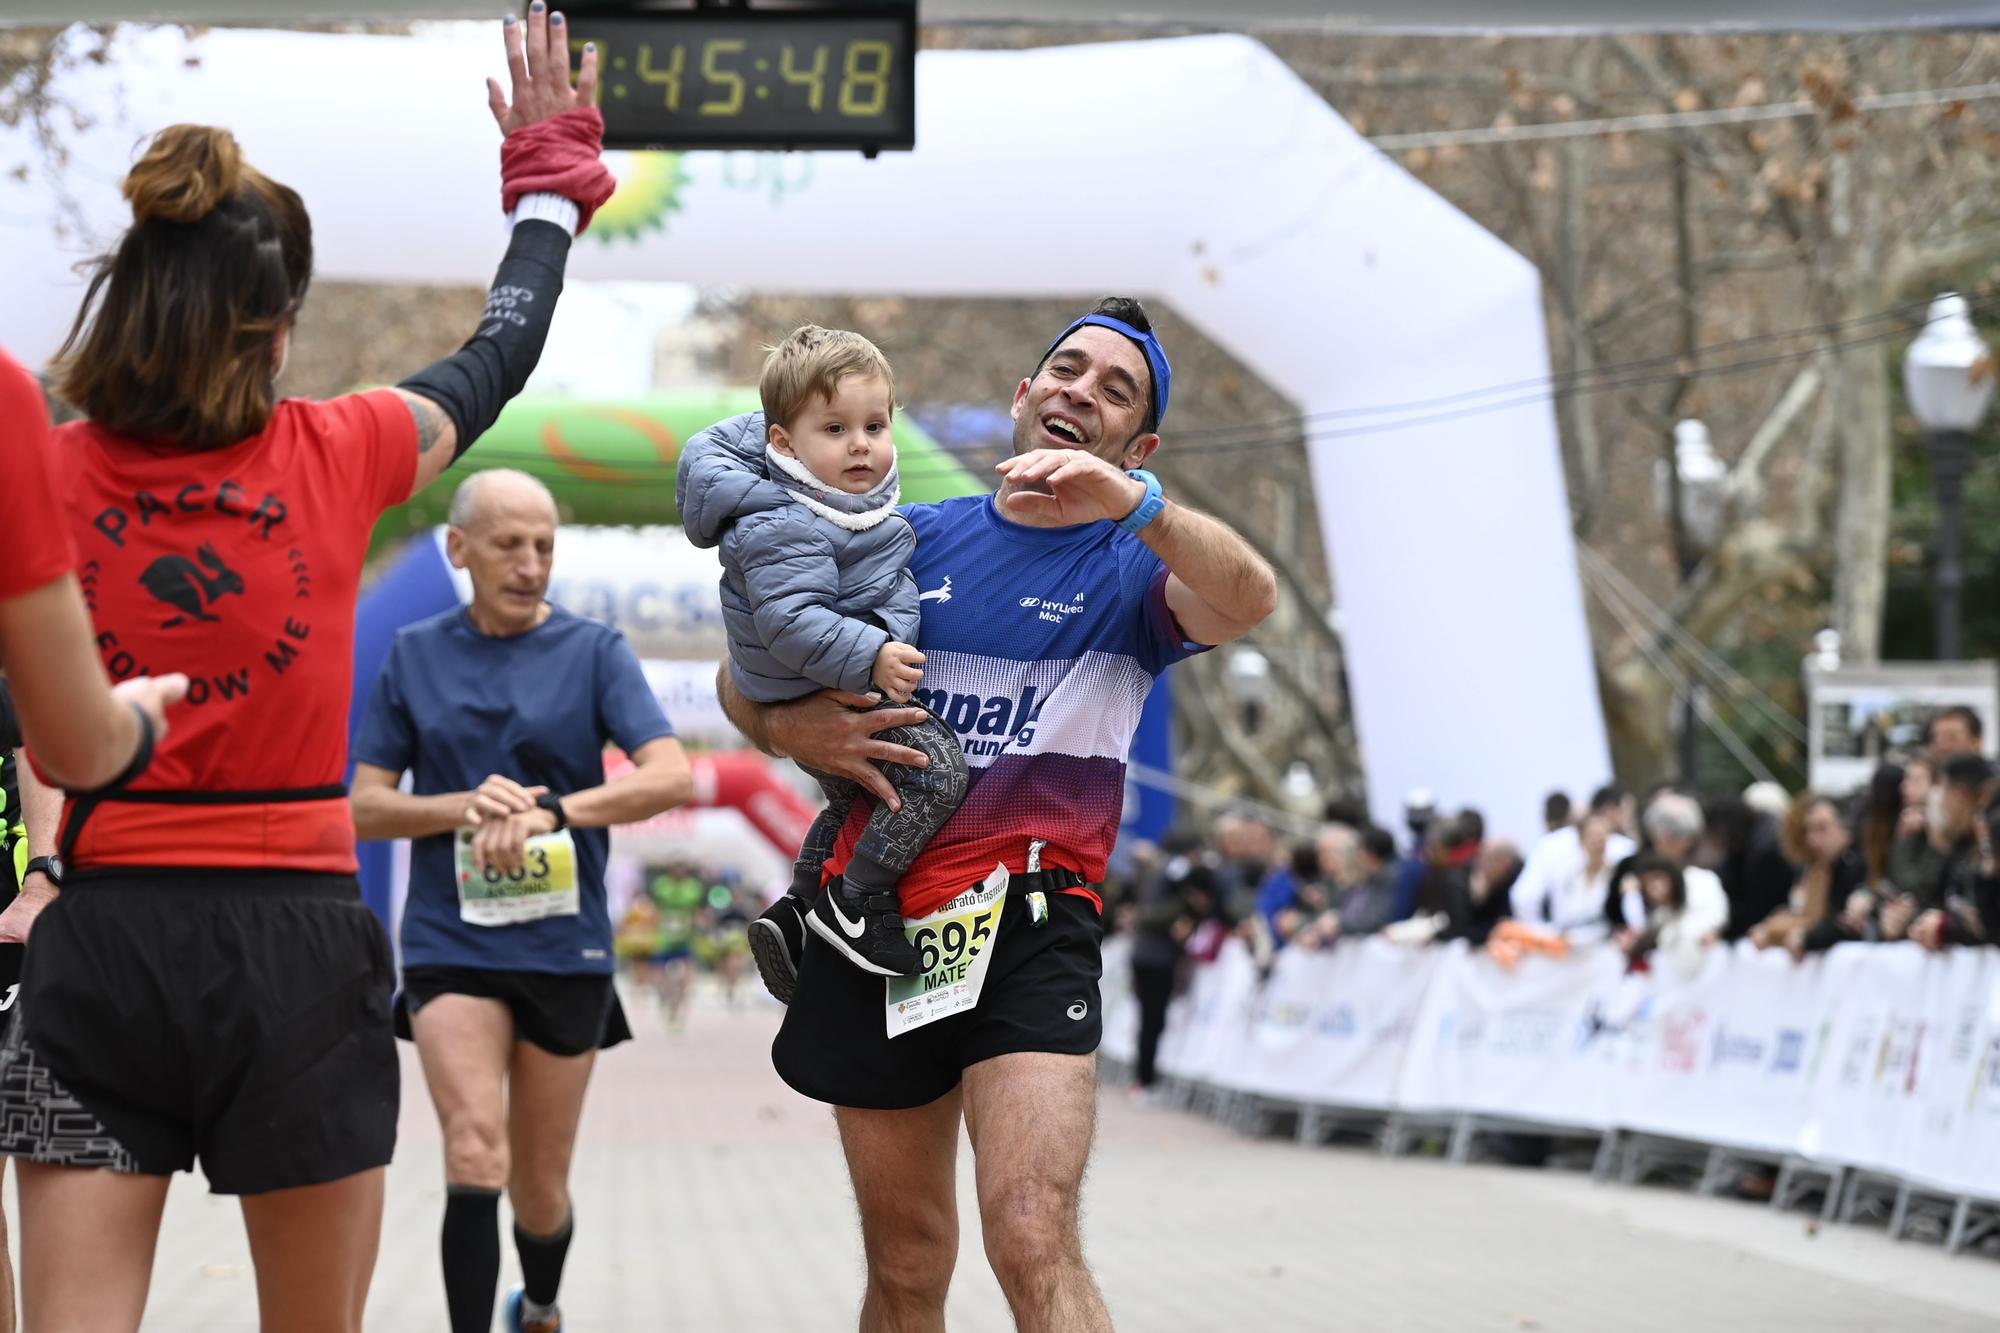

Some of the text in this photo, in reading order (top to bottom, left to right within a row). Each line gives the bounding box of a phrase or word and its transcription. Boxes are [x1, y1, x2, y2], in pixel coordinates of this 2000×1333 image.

[93, 480, 288, 547] PACER
[96, 615, 310, 705] FOOW ME
[917, 686, 1041, 738] mpal
[963, 727, 1036, 757] rung
[914, 911, 992, 974] 695
[925, 959, 974, 991] MATE
